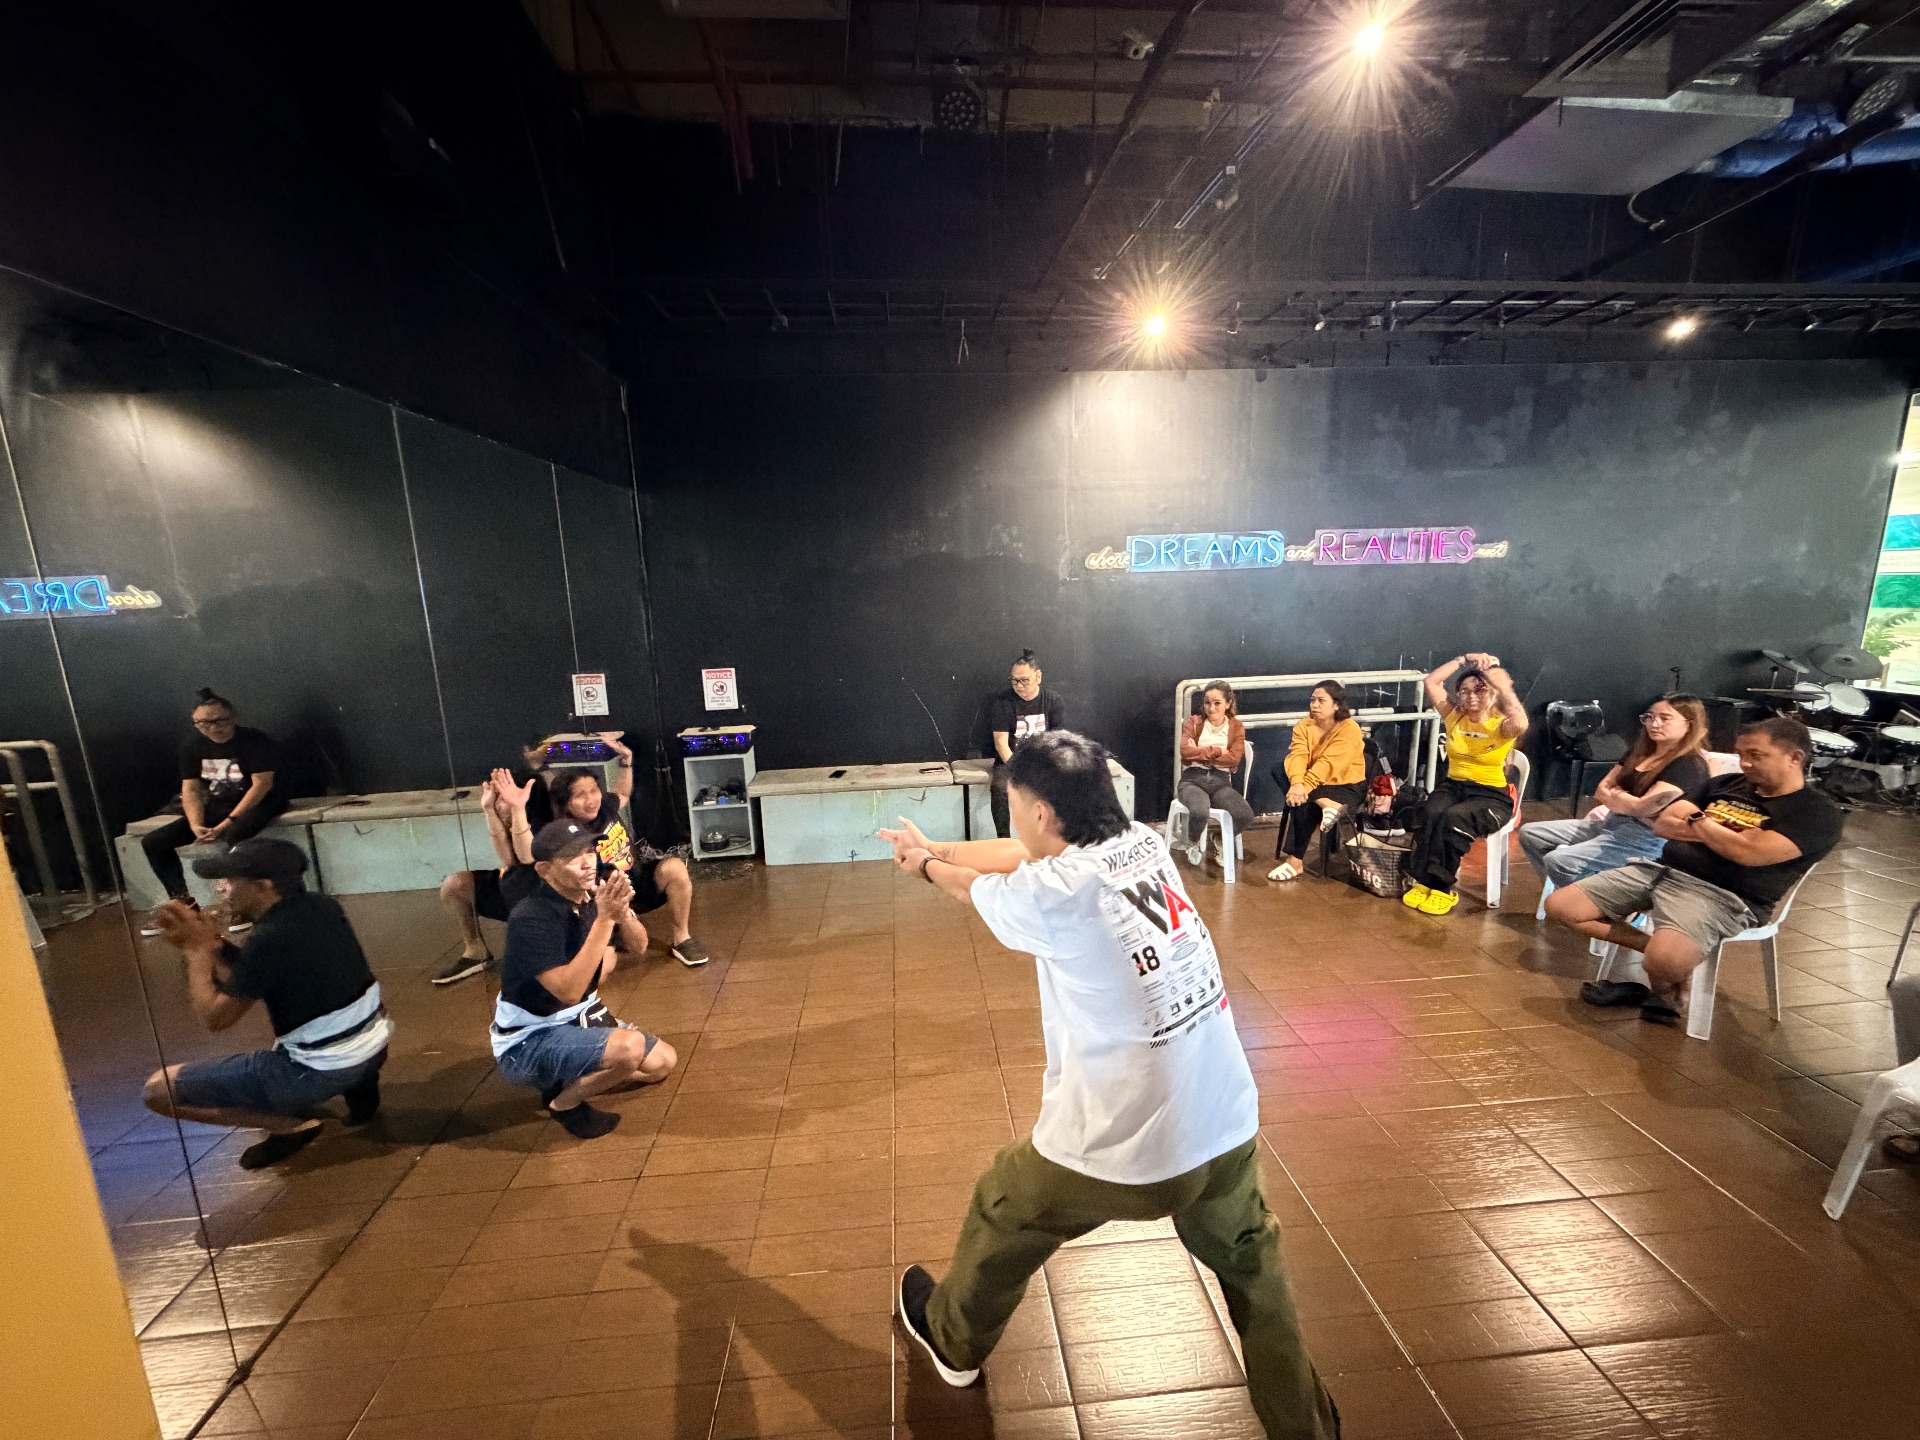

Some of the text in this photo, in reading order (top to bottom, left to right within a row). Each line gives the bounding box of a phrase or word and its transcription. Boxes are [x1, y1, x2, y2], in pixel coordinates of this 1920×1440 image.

[1131, 534, 1281, 567] DREAMS
[1286, 543, 1316, 559] and
[1319, 530, 1474, 562] REALITIES
[706, 671, 732, 679] NOTICE
[1131, 945, 1161, 977] 18
